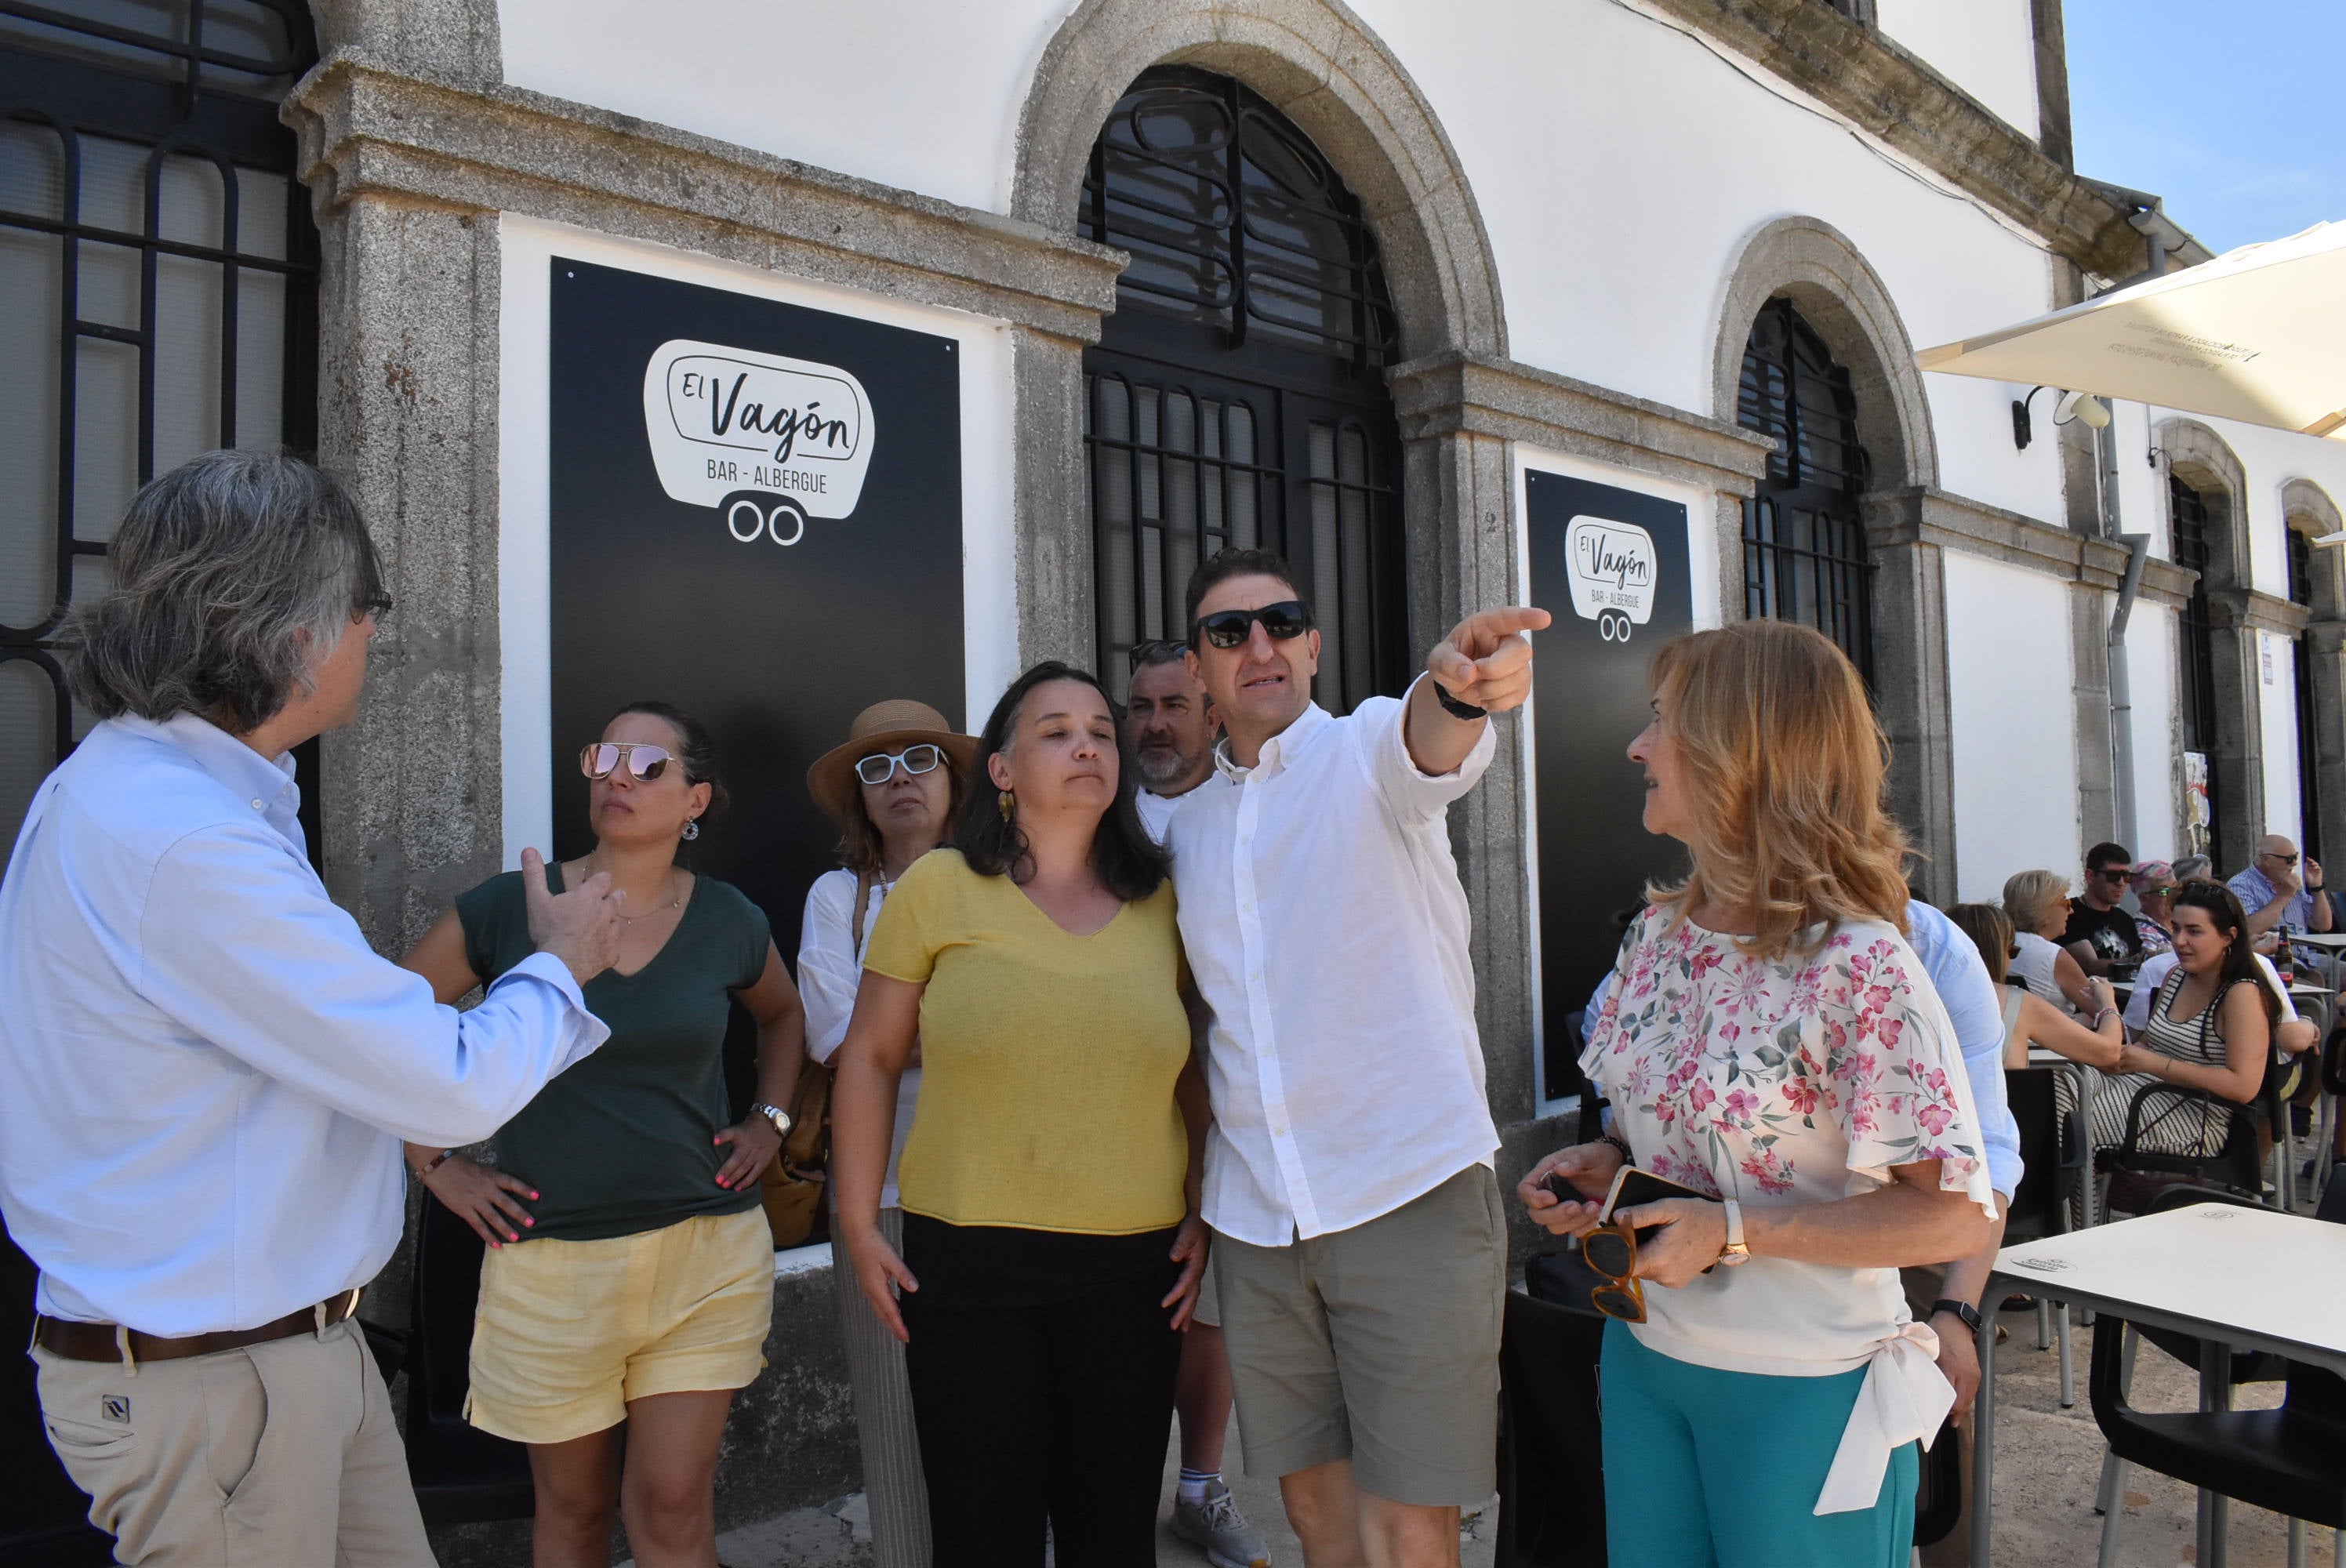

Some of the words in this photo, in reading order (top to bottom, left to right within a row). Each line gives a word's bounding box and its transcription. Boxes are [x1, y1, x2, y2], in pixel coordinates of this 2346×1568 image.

[682, 373, 704, 399] El
[712, 372, 849, 463] Vagón
[707, 458, 738, 483] BAR
[754, 465, 827, 494] ALBERGUE
[1580, 535, 1589, 553] El
[1592, 534, 1647, 590] Vagón
[1592, 589, 1604, 603] BAR
[1611, 593, 1639, 608] ALBERGUE
